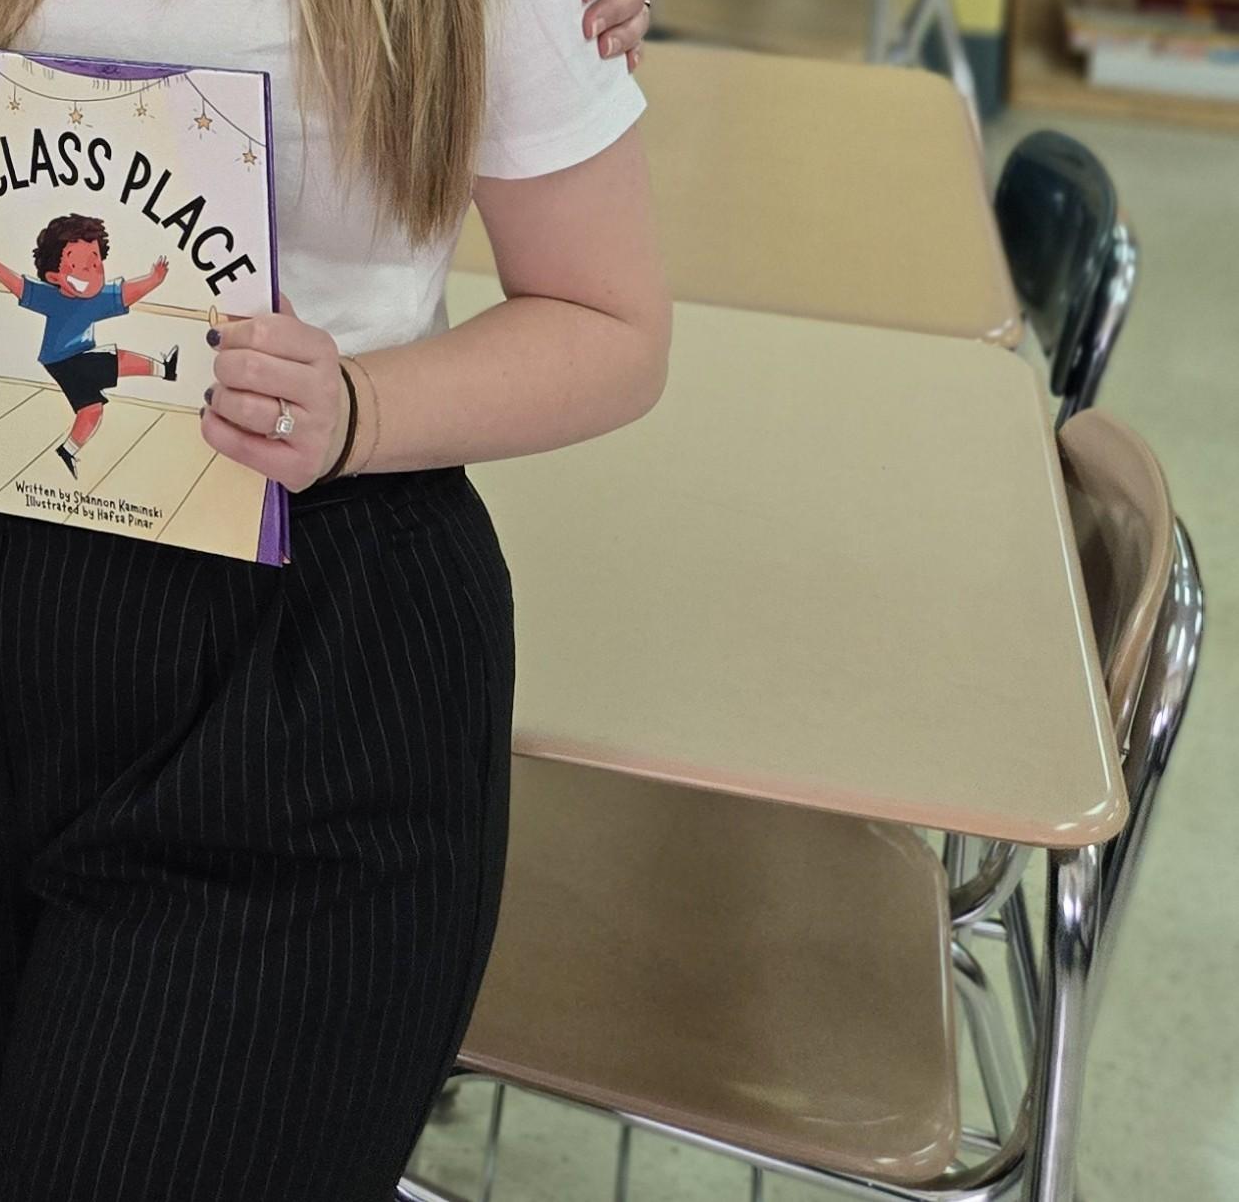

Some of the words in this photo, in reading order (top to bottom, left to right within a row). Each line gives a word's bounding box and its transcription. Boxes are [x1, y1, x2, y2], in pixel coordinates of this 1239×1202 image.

[119, 151, 257, 296] PLACE
[15, 480, 56, 498] Written
[59, 488, 71, 503] by
[73, 491, 116, 509] Shannon
[118, 499, 163, 519] Kaminski
[25, 494, 79, 515] Illustrated
[82, 505, 95, 520] by
[97, 508, 125, 524] Hafsa
